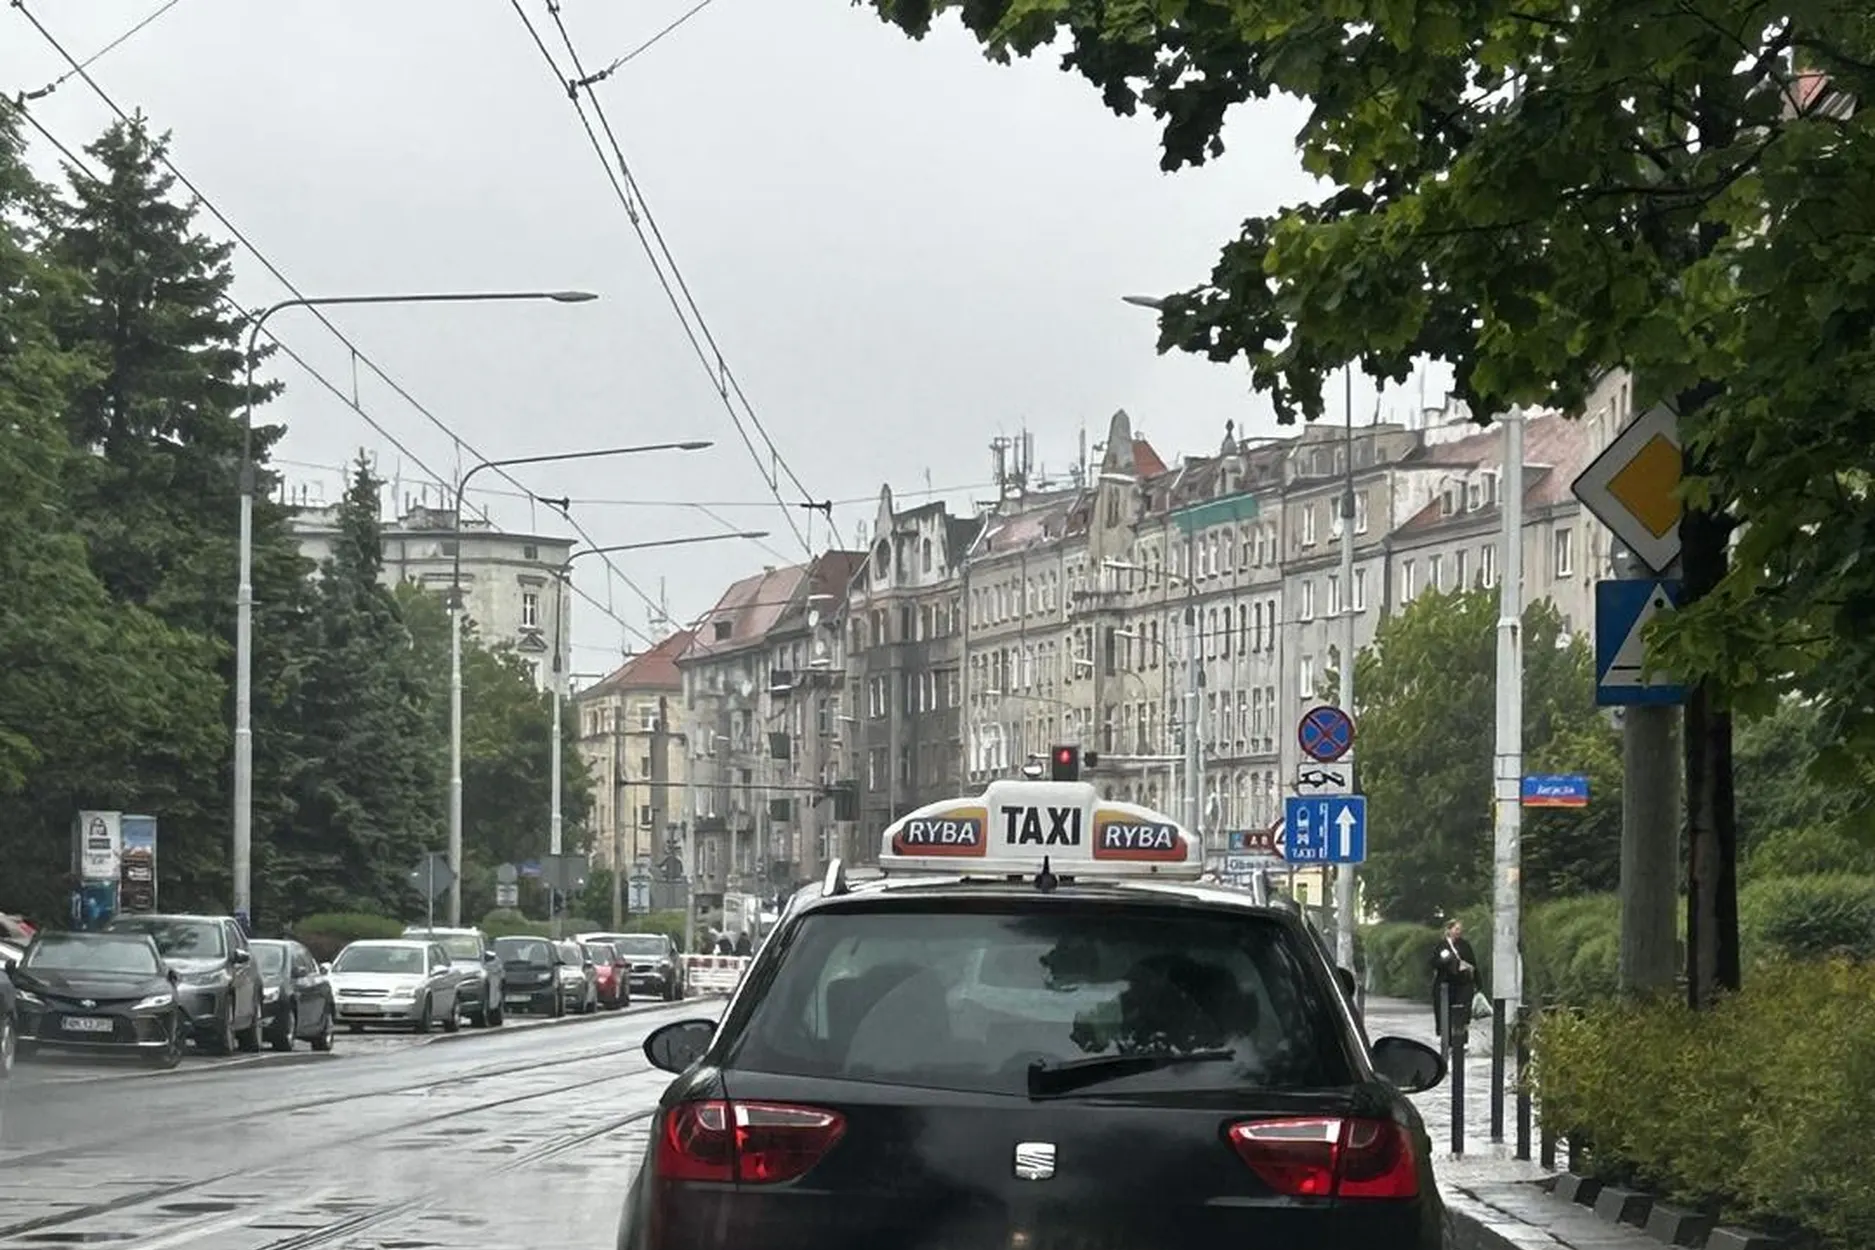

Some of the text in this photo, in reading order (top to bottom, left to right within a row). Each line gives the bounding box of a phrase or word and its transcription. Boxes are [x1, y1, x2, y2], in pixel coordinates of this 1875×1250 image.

[907, 806, 1173, 849] RYBA TAXI RYBA
